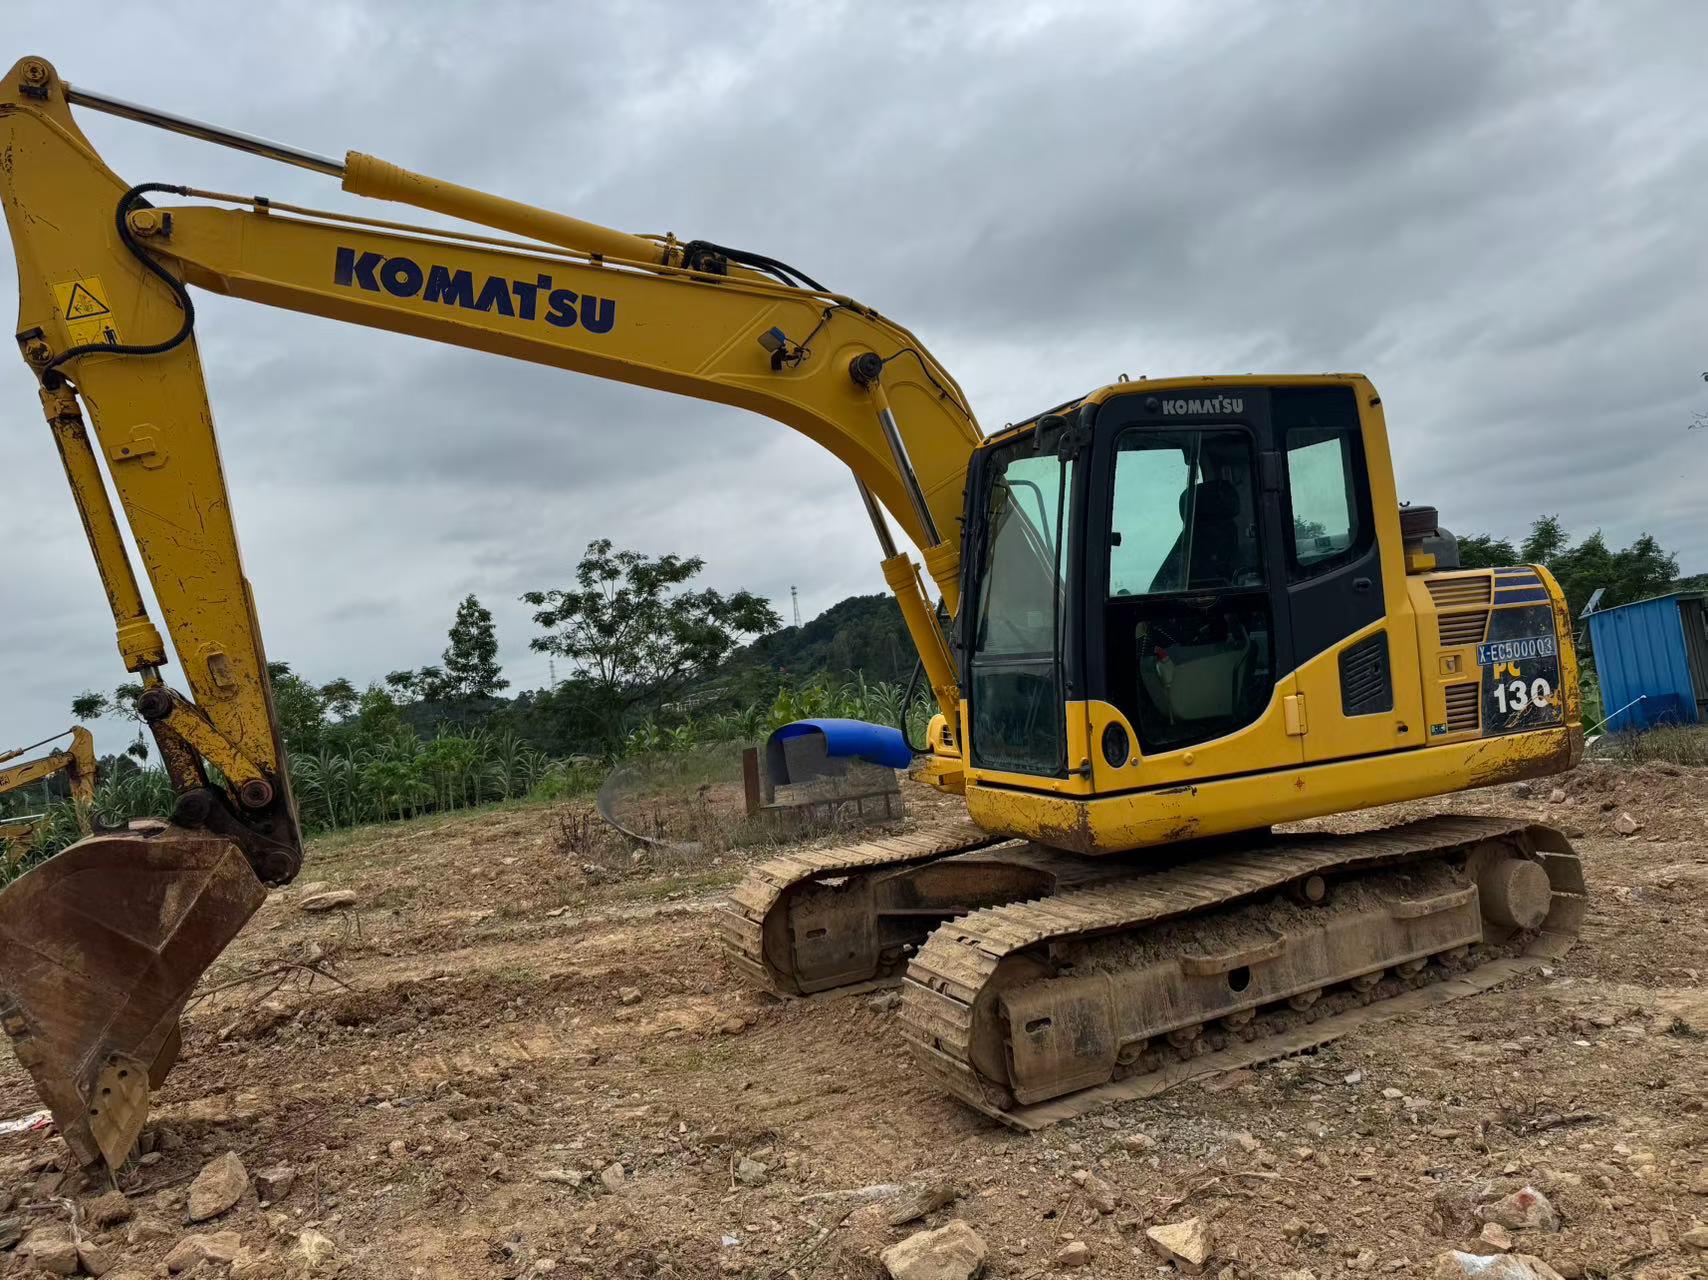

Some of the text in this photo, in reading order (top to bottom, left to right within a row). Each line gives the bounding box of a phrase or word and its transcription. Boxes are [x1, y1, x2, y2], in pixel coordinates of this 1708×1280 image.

[334, 246, 616, 334] KOMATSU
[1162, 395, 1244, 415] KOMATSU
[1493, 677, 1551, 713] 130
